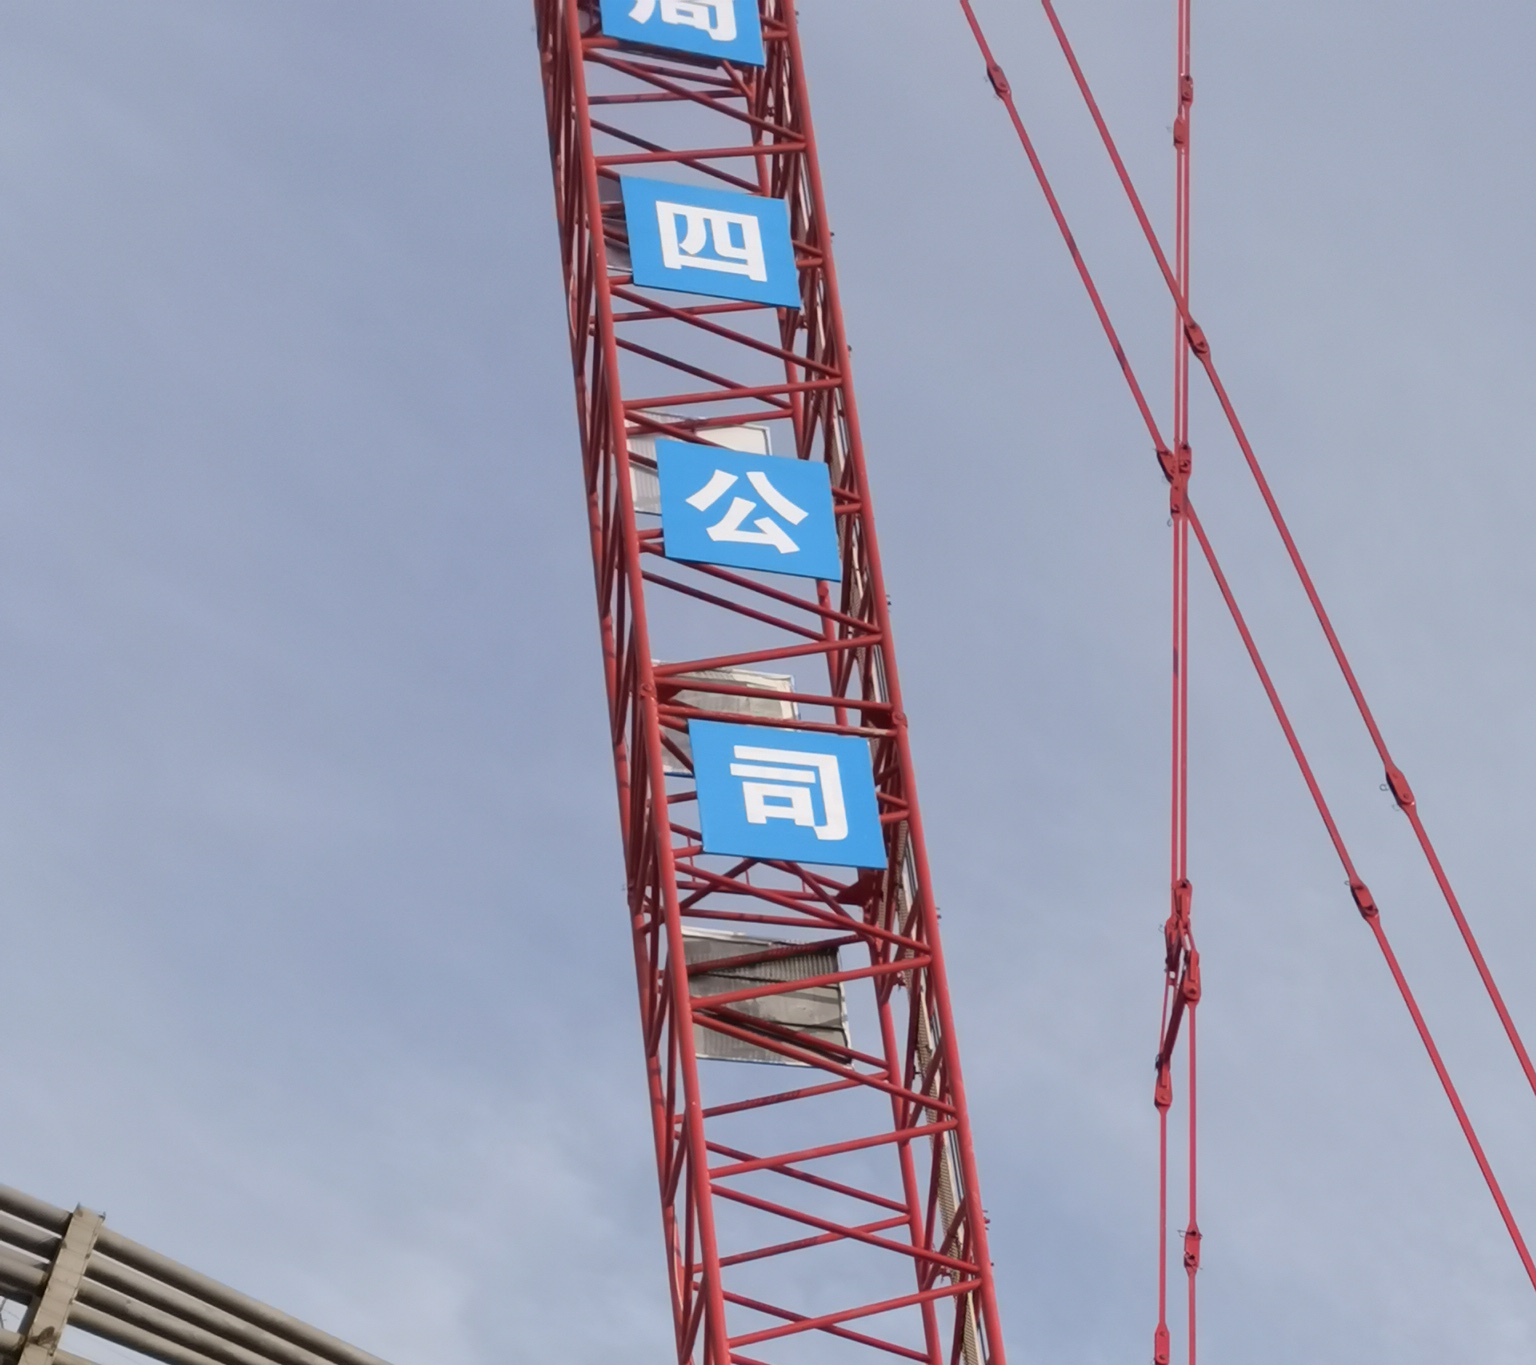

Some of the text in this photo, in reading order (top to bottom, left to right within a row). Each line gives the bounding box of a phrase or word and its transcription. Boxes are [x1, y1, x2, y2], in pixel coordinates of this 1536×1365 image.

[656, 200, 768, 282] 四
[686, 469, 809, 554] 公
[730, 745, 848, 841] 司
